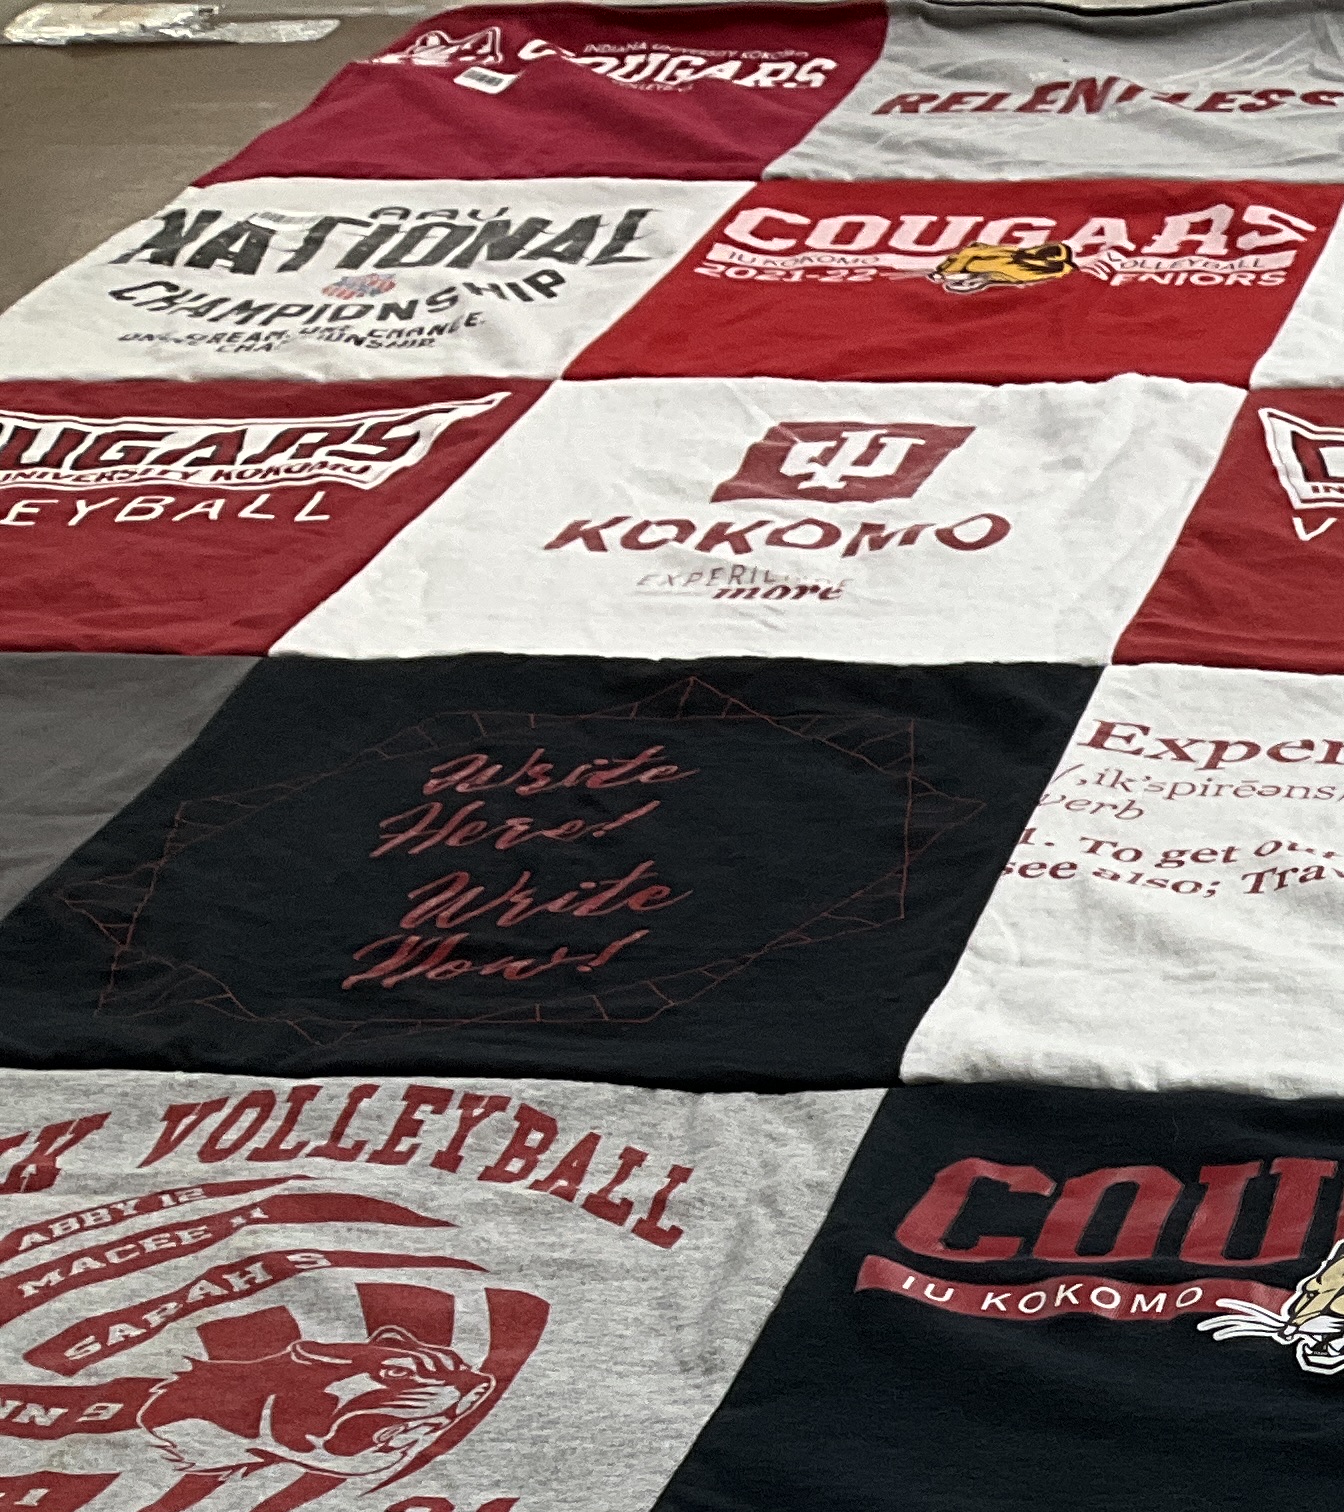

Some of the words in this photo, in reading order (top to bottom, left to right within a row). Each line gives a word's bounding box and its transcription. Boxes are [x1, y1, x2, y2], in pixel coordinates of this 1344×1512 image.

[108, 207, 665, 275] NATIONAL
[722, 203, 1316, 255] COUGARS
[108, 267, 567, 326] CHAMPIONSHIP
[694, 261, 879, 282] 2021-22
[1109, 271, 1288, 286] ENIORS
[0, 407, 462, 472] UGARS
[543, 512, 1012, 557] KOKOMO
[712, 584, 843, 601] more
[423, 745, 699, 797] Write
[1039, 792, 1144, 821] verb
[1080, 836, 1143, 863] To
[1154, 845, 1241, 868] get
[400, 860, 693, 929] Write
[1000, 861, 1078, 880] see
[1092, 867, 1221, 898] also;
[0, 1110, 112, 1195] K
[136, 1082, 694, 1249] VOLLEYBALL
[18, 1198, 141, 1251] ABBY
[18, 1224, 213, 1299] MACEE
[63, 1261, 274, 1361] SARAH
[902, 1275, 956, 1302] IU
[980, 1282, 1204, 1315] KOKOMO
